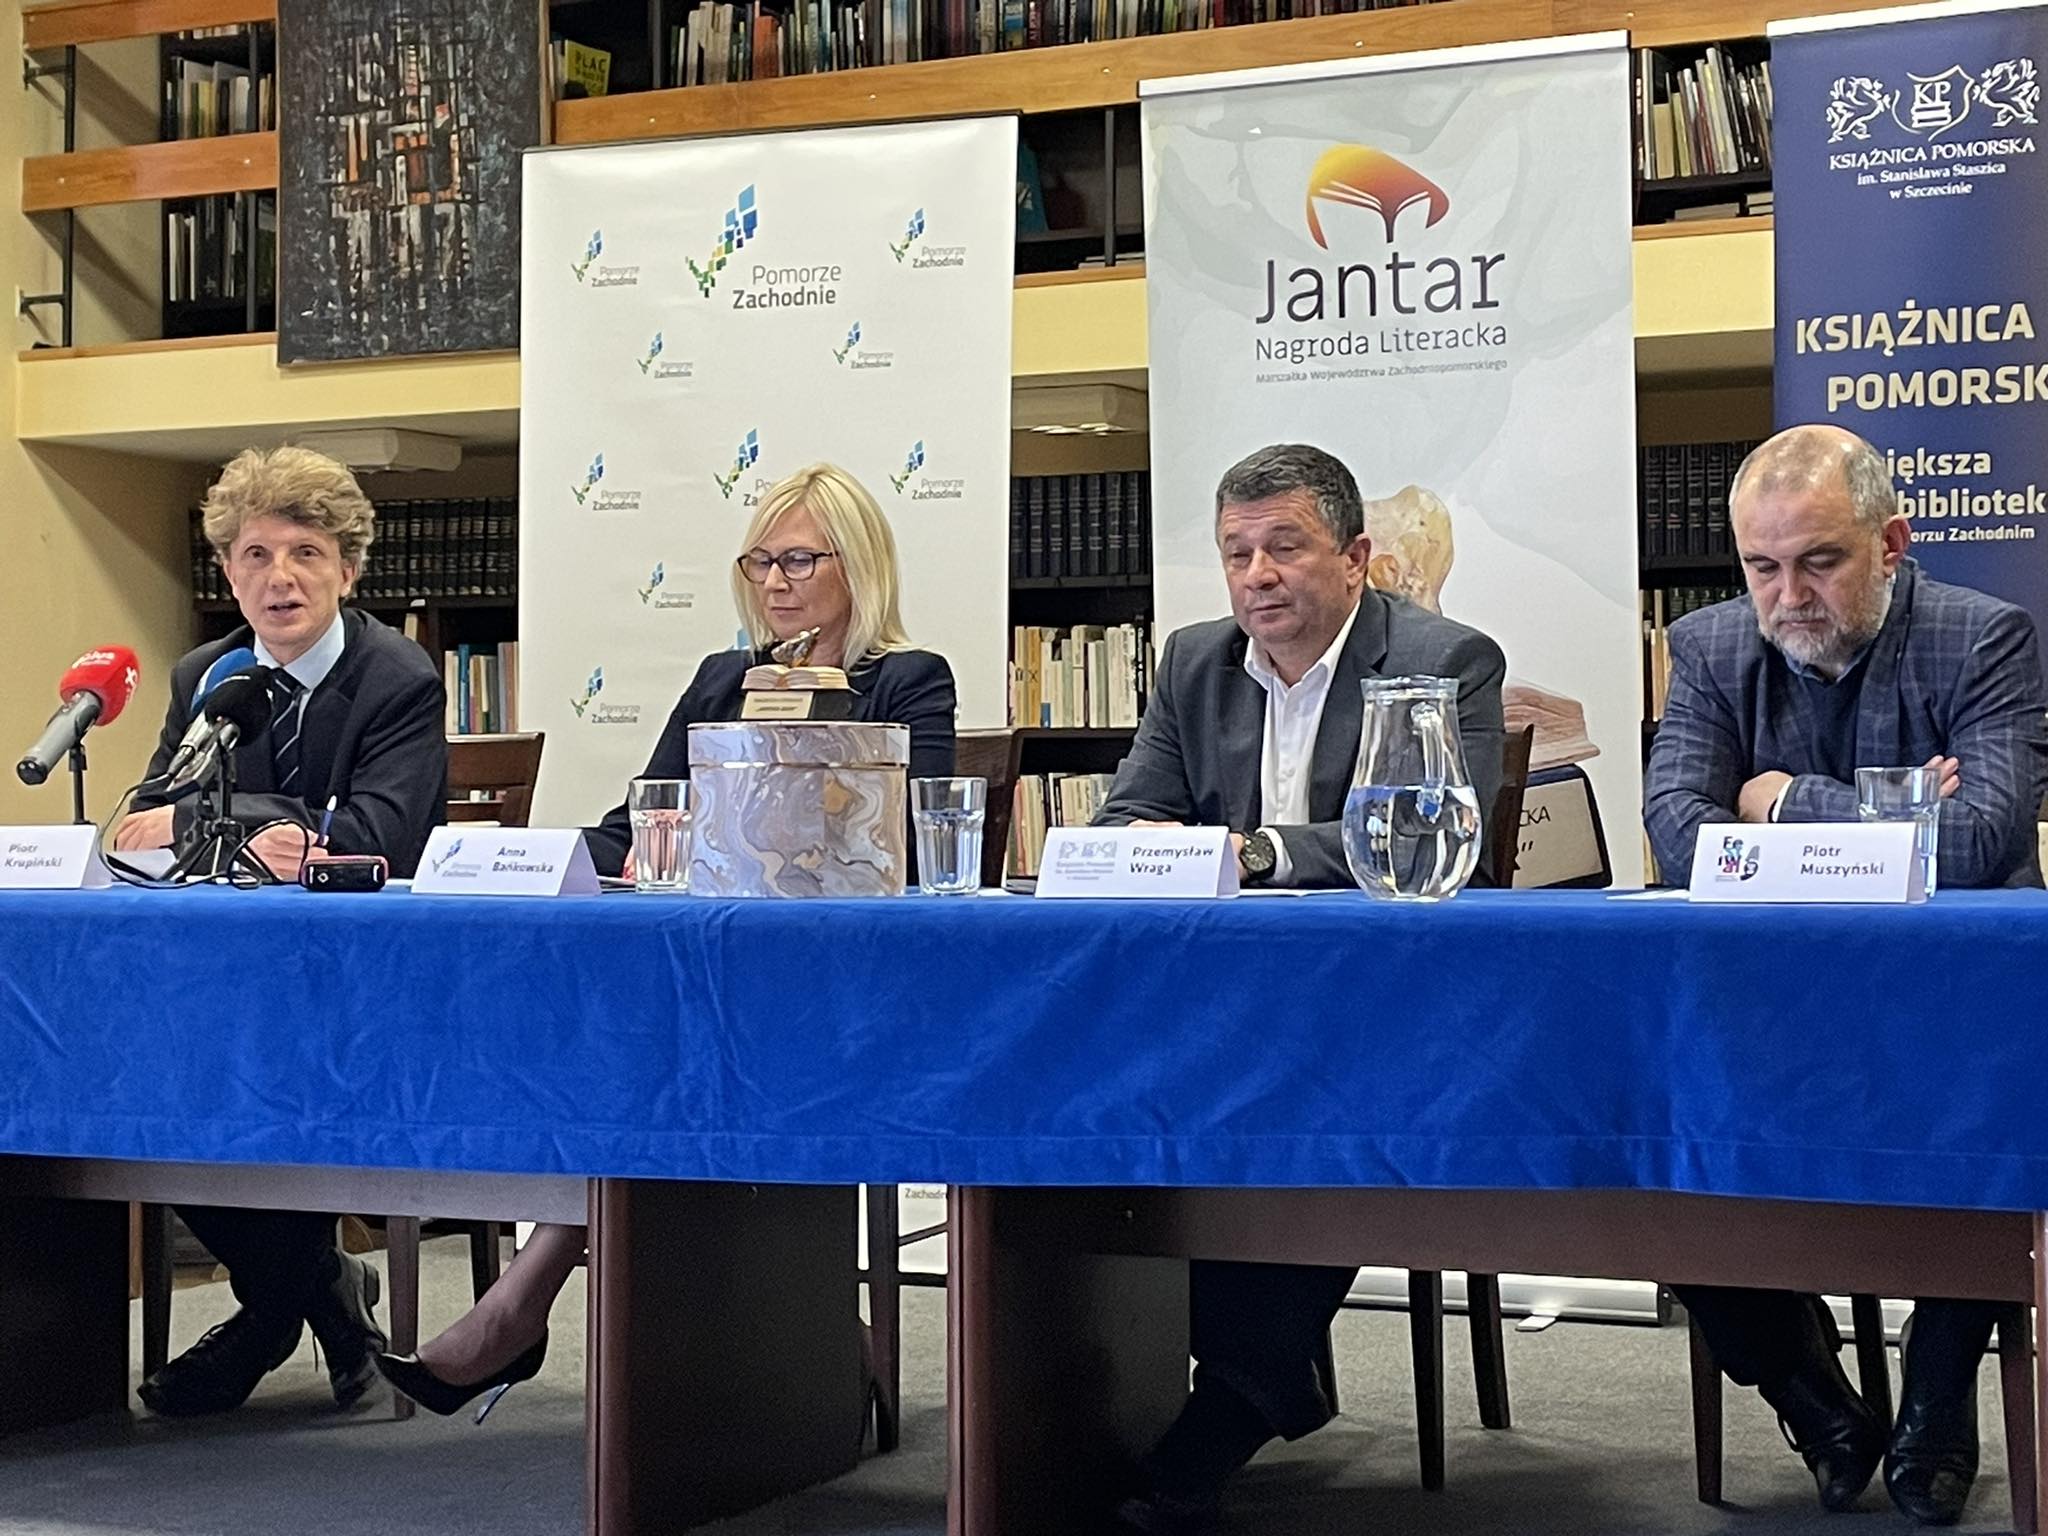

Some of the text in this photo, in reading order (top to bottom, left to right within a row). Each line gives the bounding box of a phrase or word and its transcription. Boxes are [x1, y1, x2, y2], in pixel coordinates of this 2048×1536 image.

[1913, 81, 1951, 104] KP
[1829, 137, 2036, 170] KSIĄŻNICA POMORSKA
[1857, 173, 1879, 185] im.
[1952, 162, 2006, 175] Staszica
[1889, 181, 1973, 199] w Szczecinie
[913, 257, 964, 268] Zachodnie
[752, 265, 841, 285] Pomorze
[733, 285, 836, 309] Zachodnie
[1255, 251, 1506, 324] Jantar
[1796, 299, 2035, 356] KSIĄŻNICA
[1256, 322, 1507, 364] Nagroda Literacka
[912, 489, 962, 500] Zachodnie
[1897, 484, 2047, 518] bibliotek
[1949, 524, 2035, 541] Zachodnim
[8, 843, 38, 853] Piotr
[497, 847, 526, 857] Anna
[1803, 844, 1842, 857] Piotr
[1129, 862, 1172, 875] Wraga
[1800, 862, 1885, 878] Muszyński
